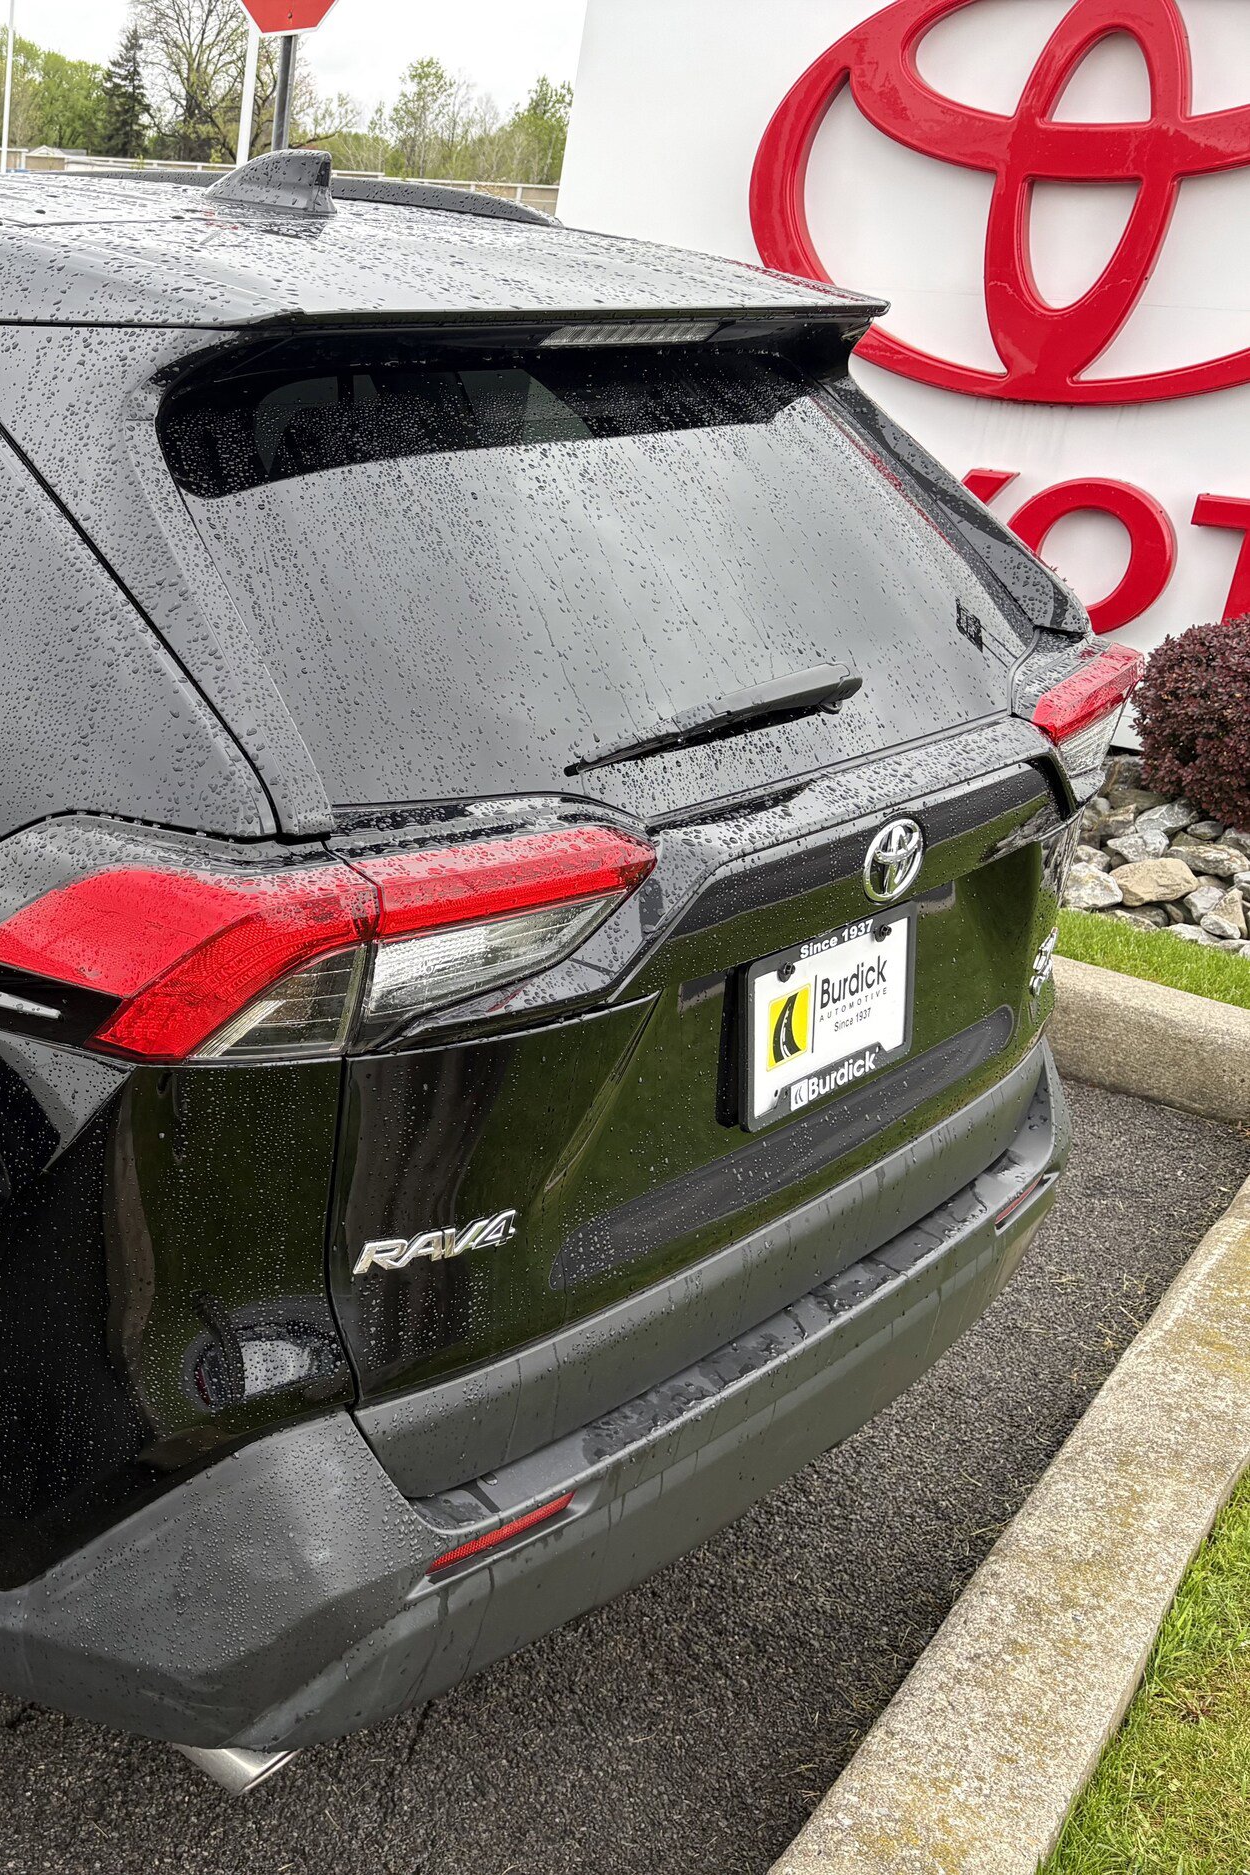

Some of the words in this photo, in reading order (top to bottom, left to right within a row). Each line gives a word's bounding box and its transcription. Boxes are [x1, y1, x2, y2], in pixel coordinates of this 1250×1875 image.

[800, 936, 839, 959] Since
[841, 919, 874, 942] 1937
[819, 986, 888, 1022] AUTOMOTIVE
[820, 955, 888, 1010] Burdick
[834, 1017, 854, 1032] Since
[855, 1008, 872, 1025] 1937
[808, 1050, 876, 1101] Burdick
[352, 1207, 517, 1275] RAV4
